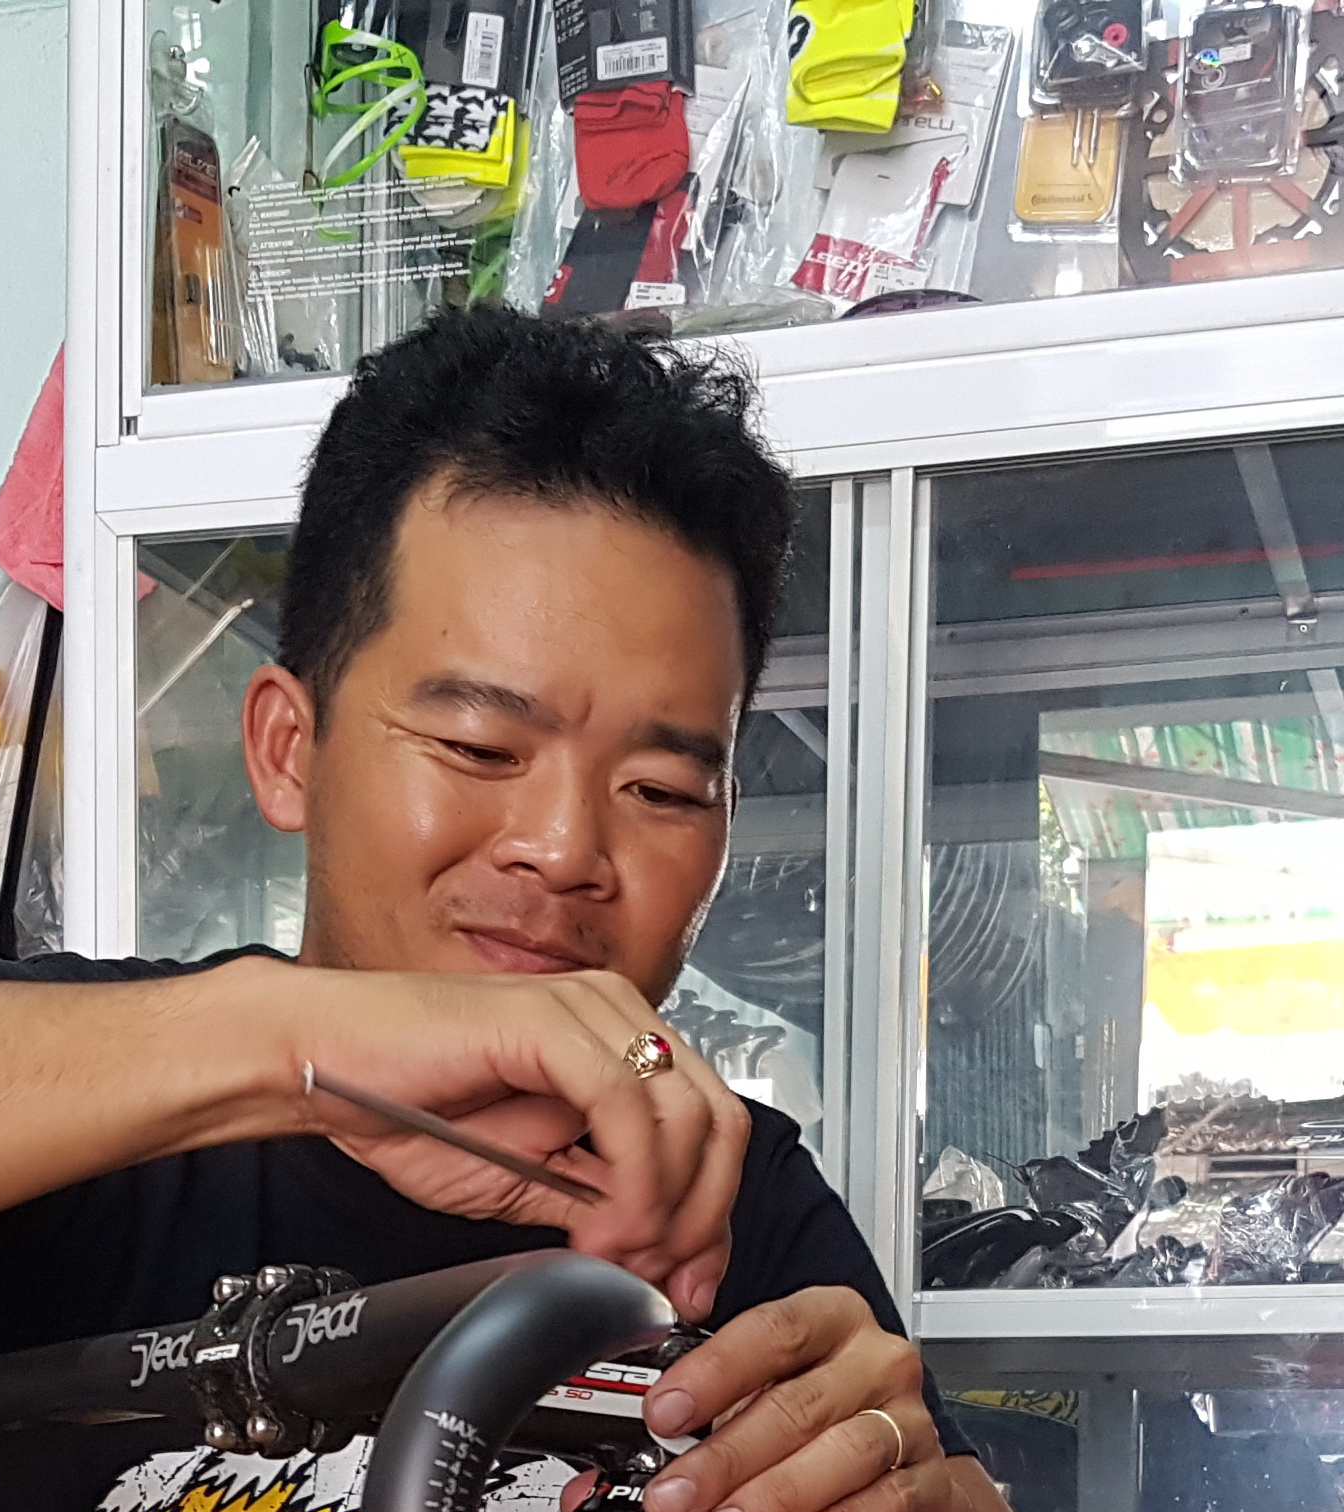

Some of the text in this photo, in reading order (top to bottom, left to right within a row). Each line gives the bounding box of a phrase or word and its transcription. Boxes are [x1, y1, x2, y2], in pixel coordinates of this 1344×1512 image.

[437, 1410, 478, 1443] MAX
[456, 1442, 470, 1460] 5
[448, 1460, 462, 1476] 4
[444, 1478, 457, 1496] 3
